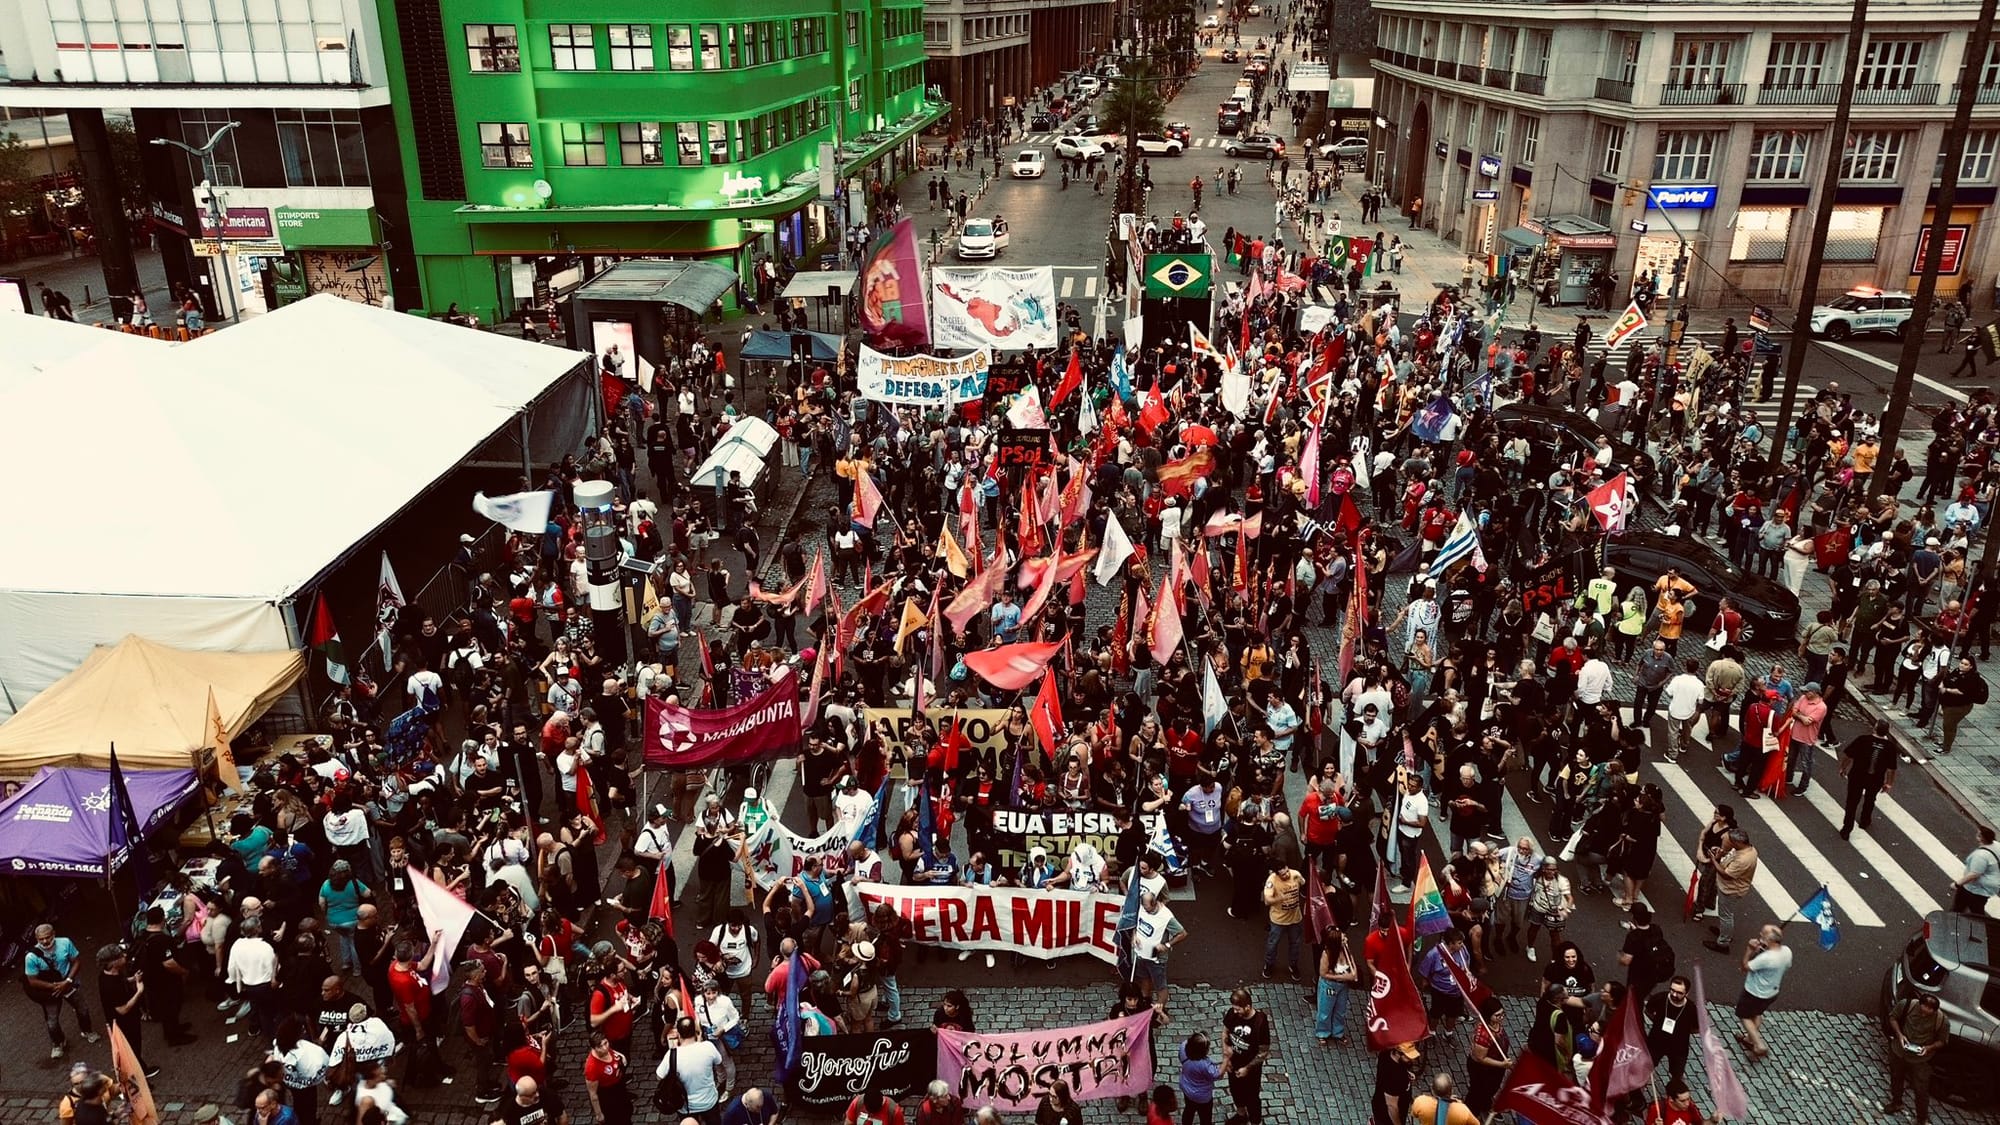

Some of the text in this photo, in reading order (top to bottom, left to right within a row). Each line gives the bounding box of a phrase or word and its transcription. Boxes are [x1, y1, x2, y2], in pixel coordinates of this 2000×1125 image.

[278, 211, 320, 220] GTIMPORTS
[279, 219, 304, 228] STORE
[885, 372, 988, 399] DEFESA PAZ
[703, 700, 792, 742] MARABUNTA
[18, 804, 73, 817] Fernanda
[994, 810, 1046, 834] EUA
[1052, 812, 1067, 834] E
[320, 1010, 348, 1020] SAÚDE
[963, 1028, 1127, 1063] COLUMNA
